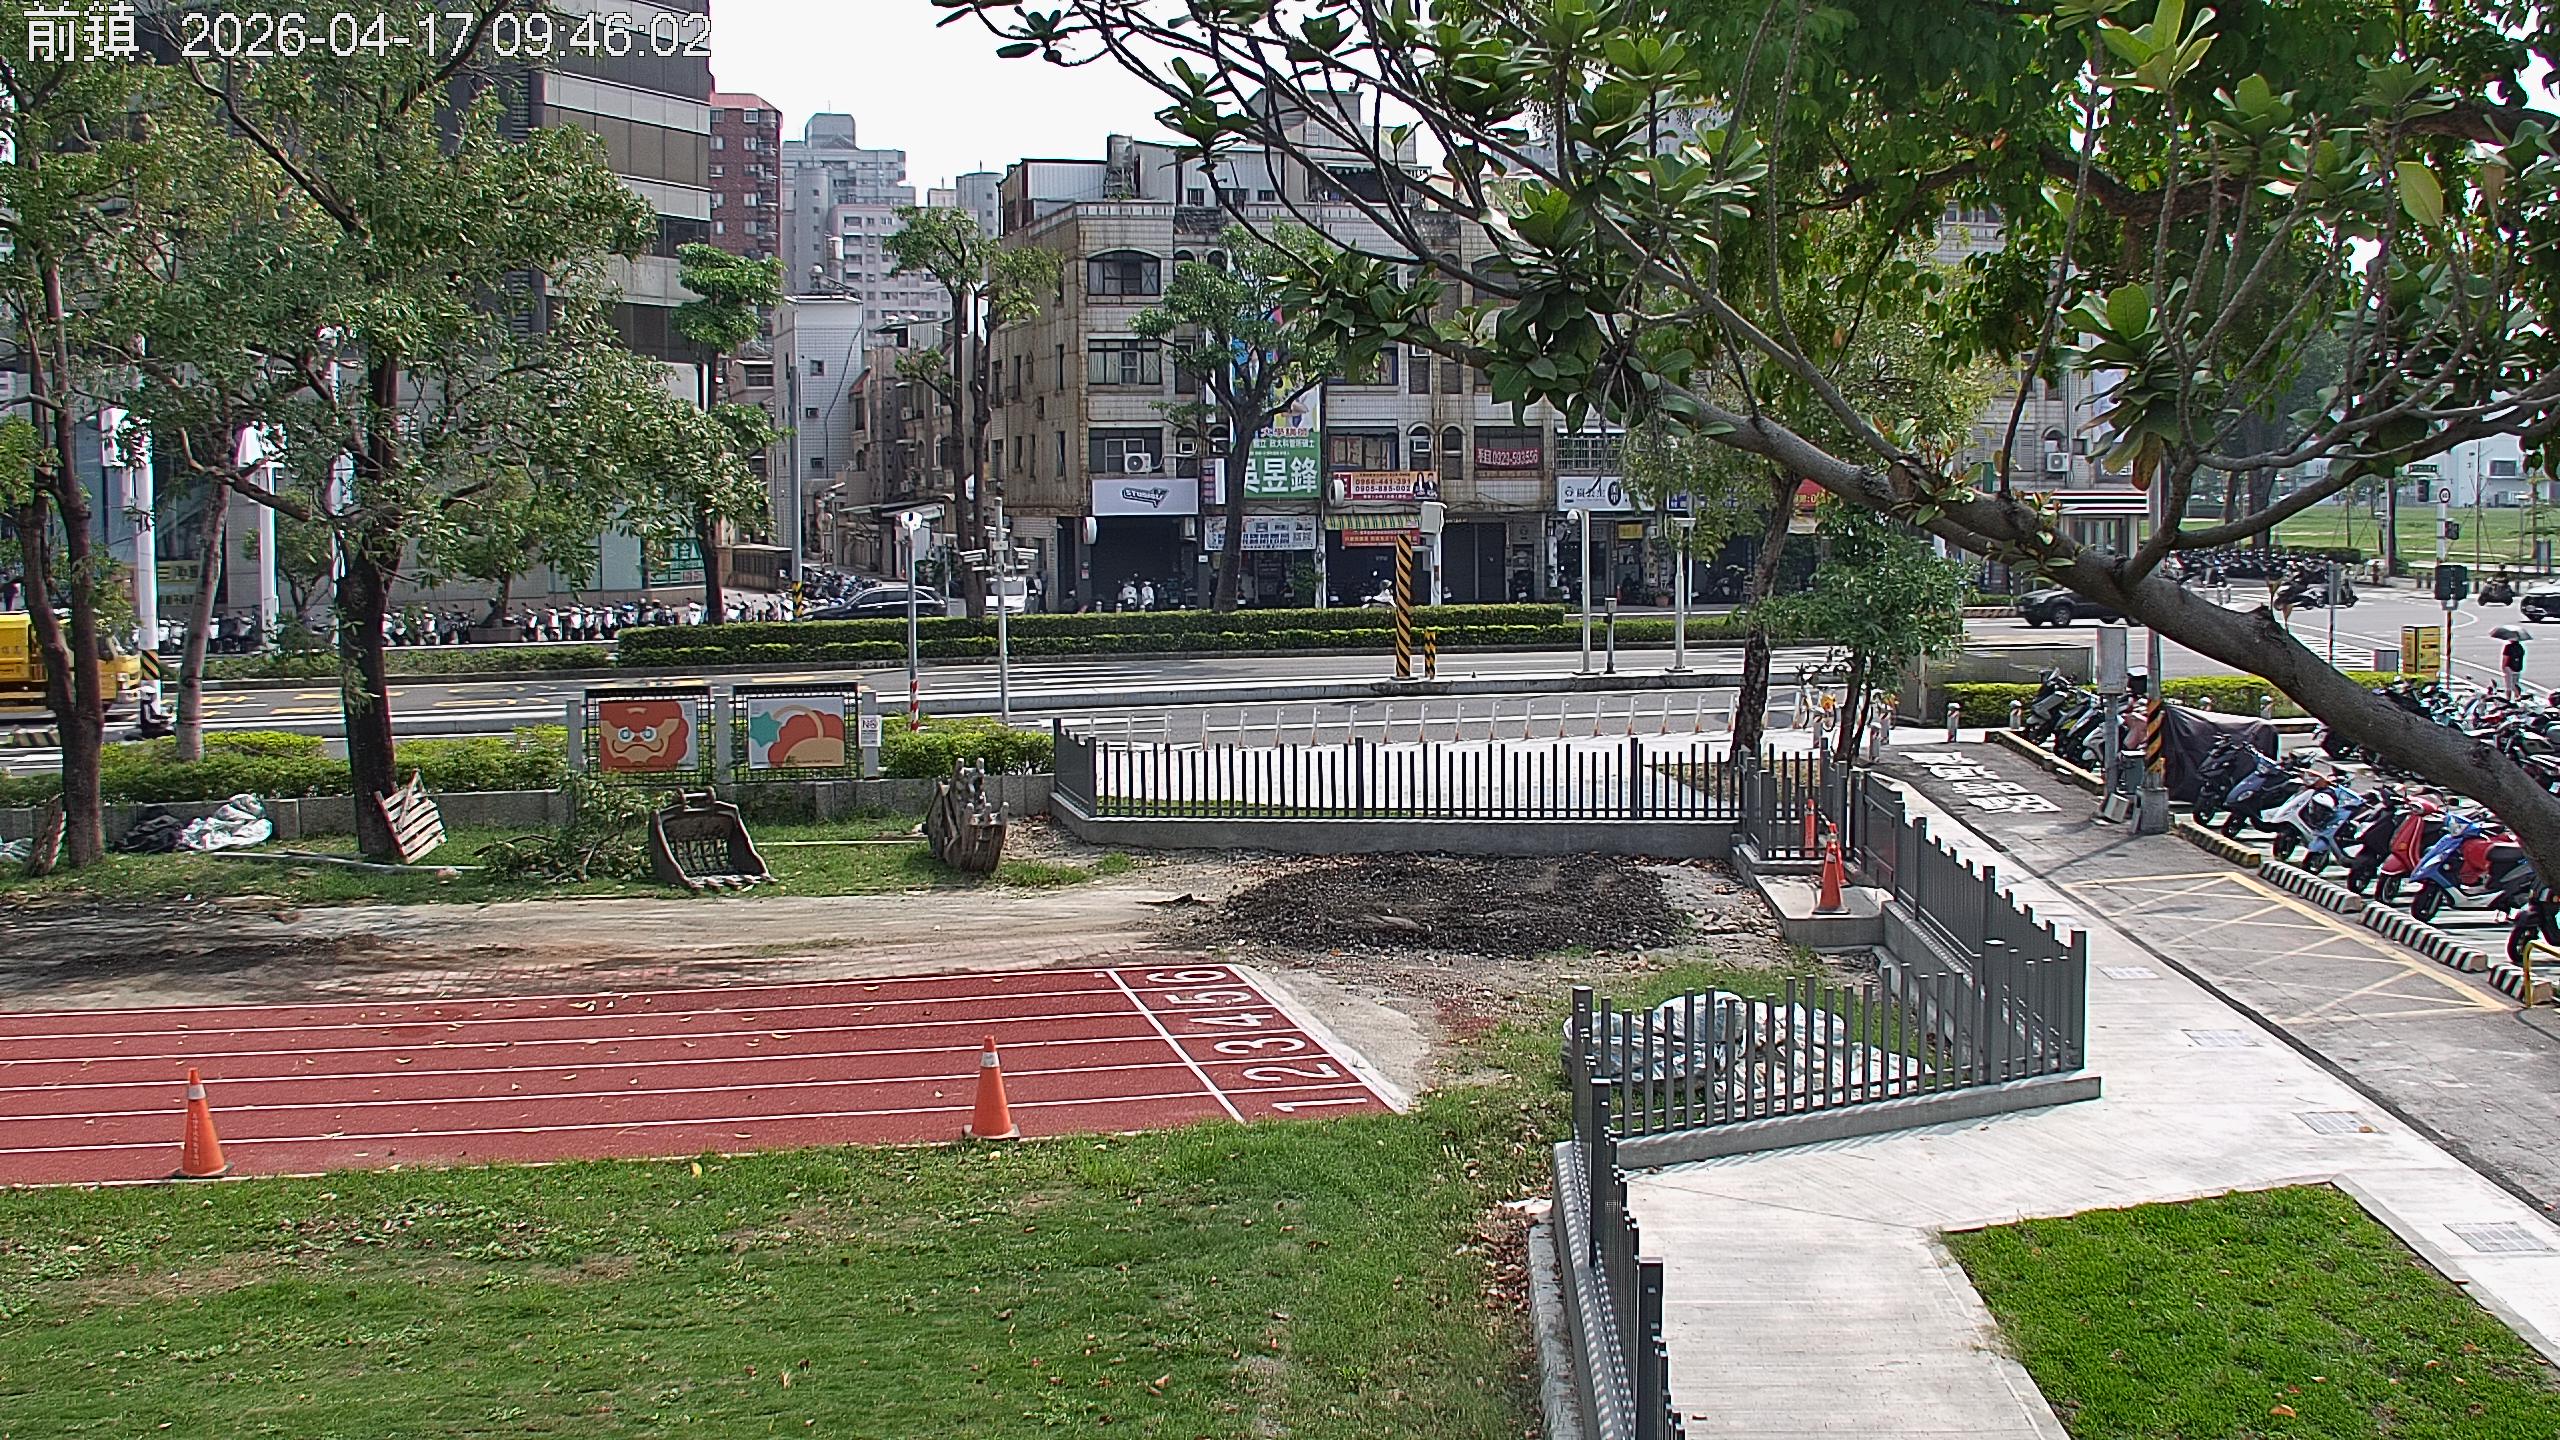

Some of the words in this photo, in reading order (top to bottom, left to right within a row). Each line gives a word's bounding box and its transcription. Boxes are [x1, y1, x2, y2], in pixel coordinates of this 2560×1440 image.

[1146, 969, 1227, 984] 6
[1166, 990, 1252, 1006] 5
[1189, 1013, 1273, 1027] 4
[1213, 1036, 1306, 1055] 3
[1242, 1062, 1340, 1082] 2
[1272, 1097, 1368, 1112] 1
